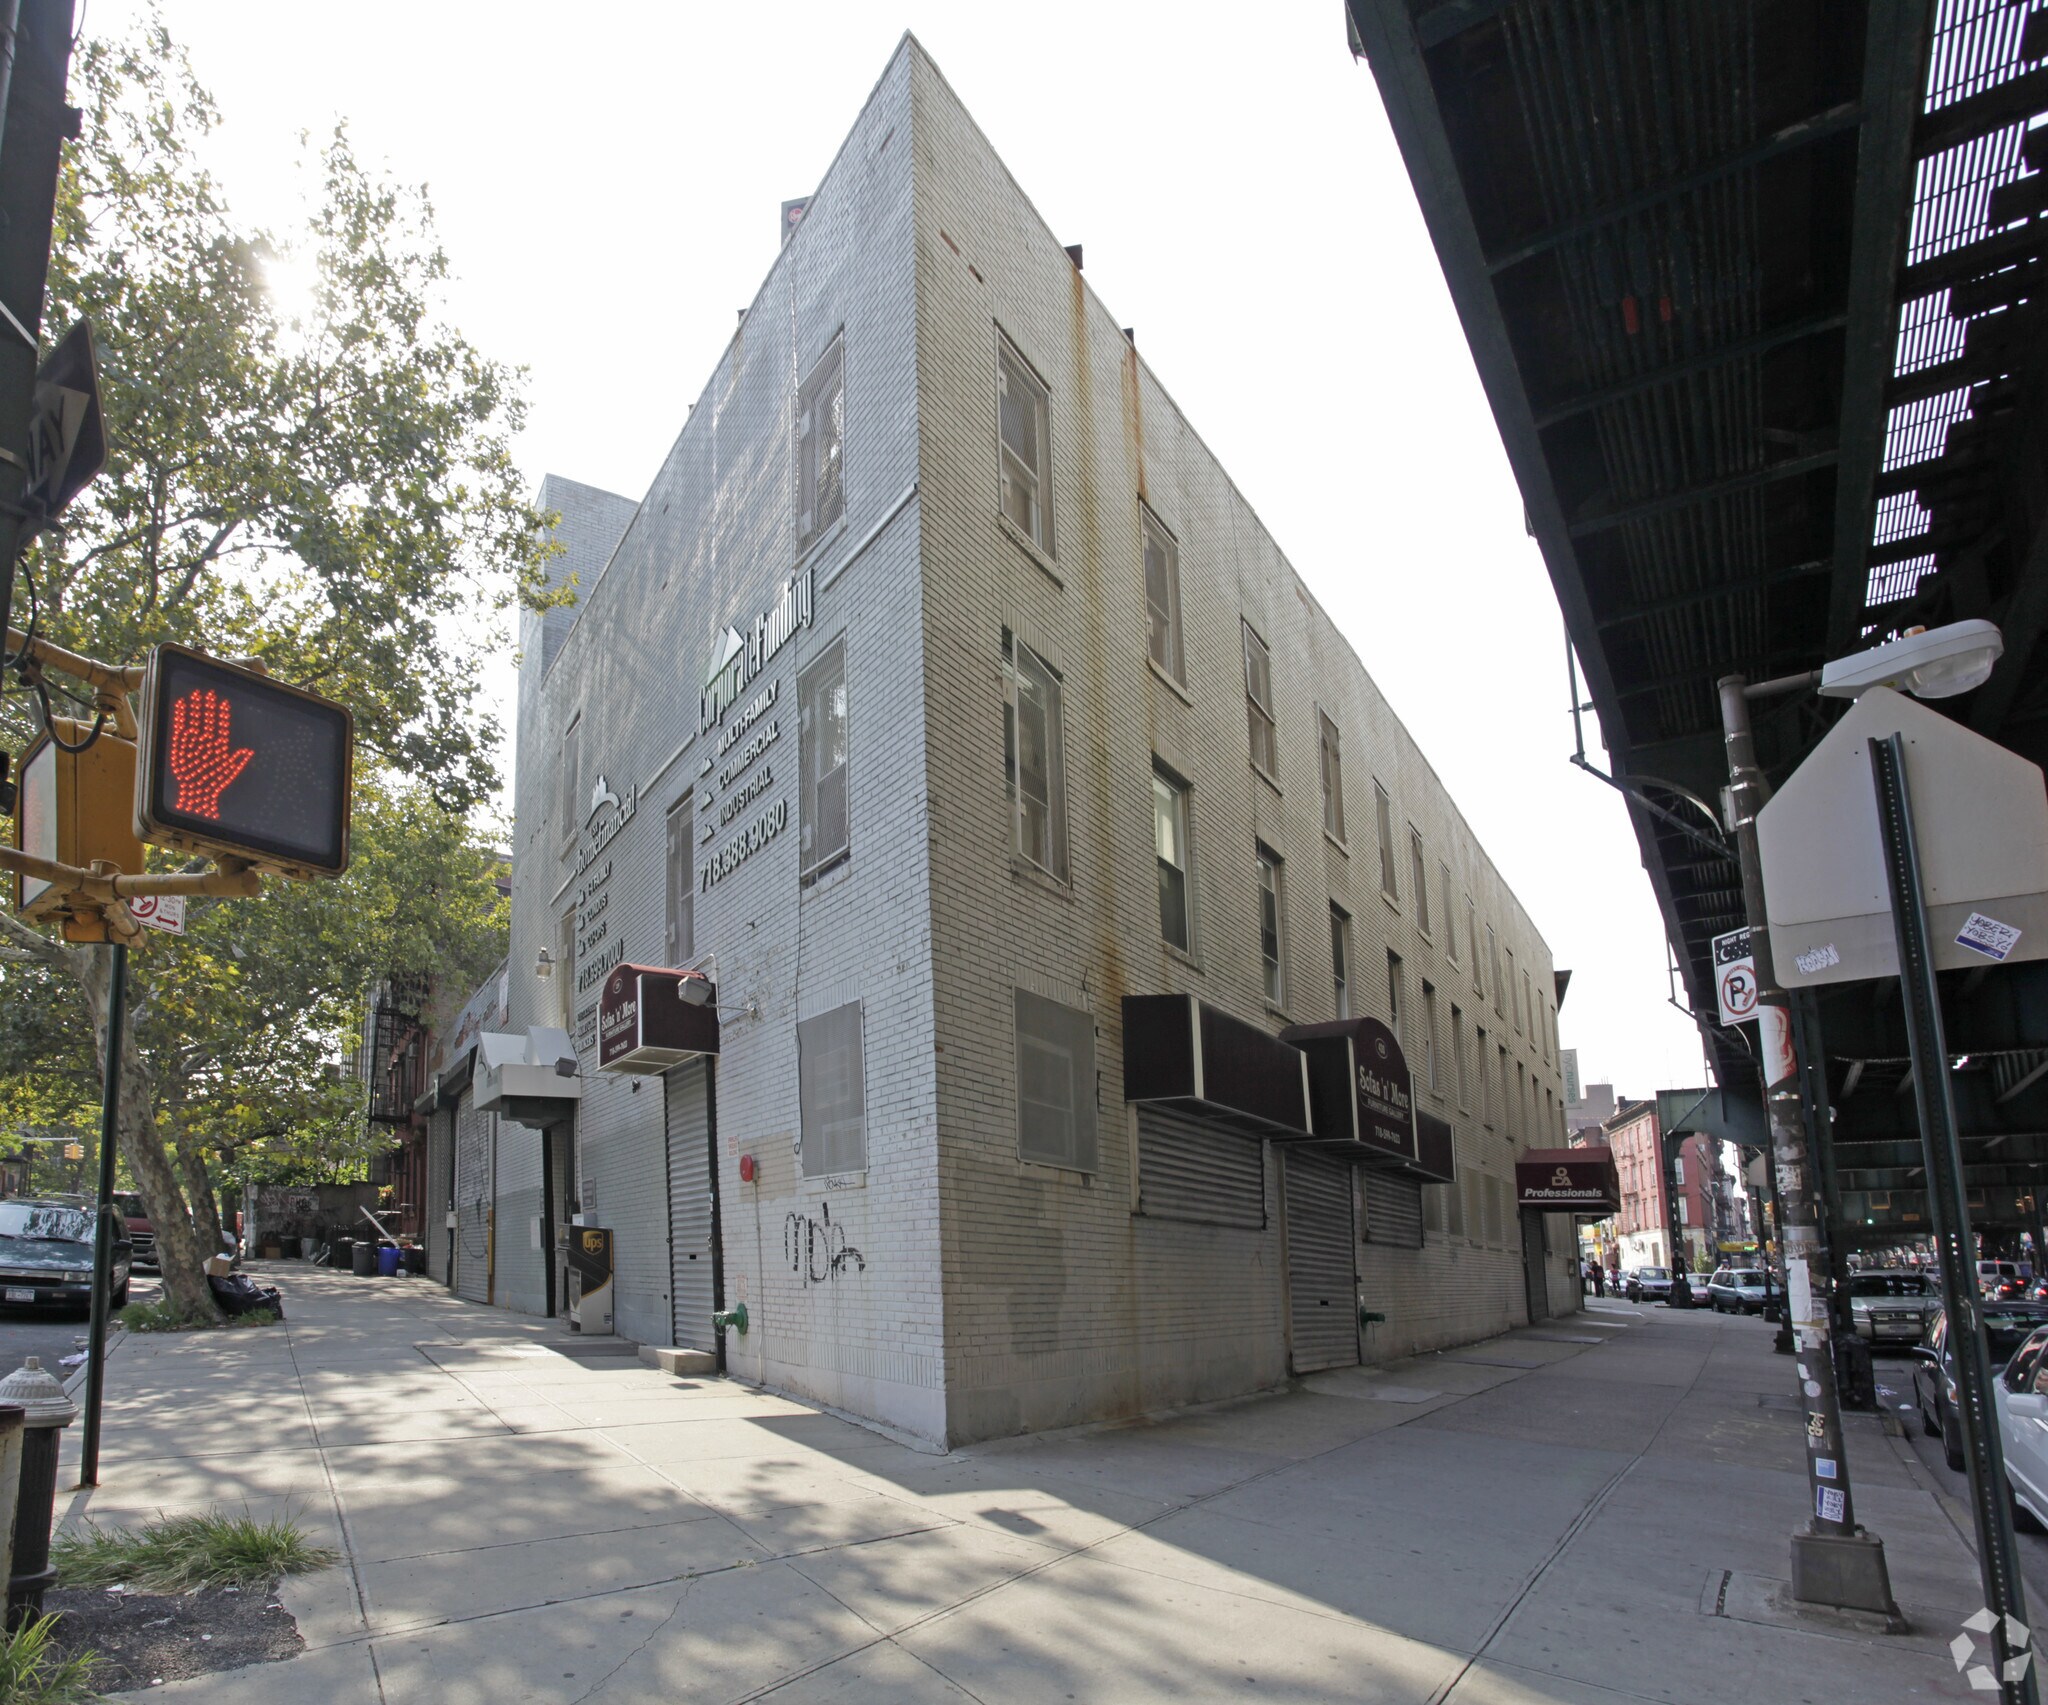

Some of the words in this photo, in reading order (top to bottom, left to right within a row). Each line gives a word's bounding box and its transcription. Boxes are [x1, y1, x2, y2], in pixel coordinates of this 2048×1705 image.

[717, 679, 779, 757] MULTI-FAMILY
[718, 720, 780, 791] COMMERCIAL
[718, 765, 773, 827] INDUSTRIAL
[700, 798, 787, 893] 718.388.9080
[1721, 936, 1737, 946] NIGHT
[1360, 1065, 1381, 1097] Sofas
[1391, 1082, 1409, 1109] More
[1524, 1188, 1603, 1198] Professionals
[584, 1237, 603, 1252] ups
